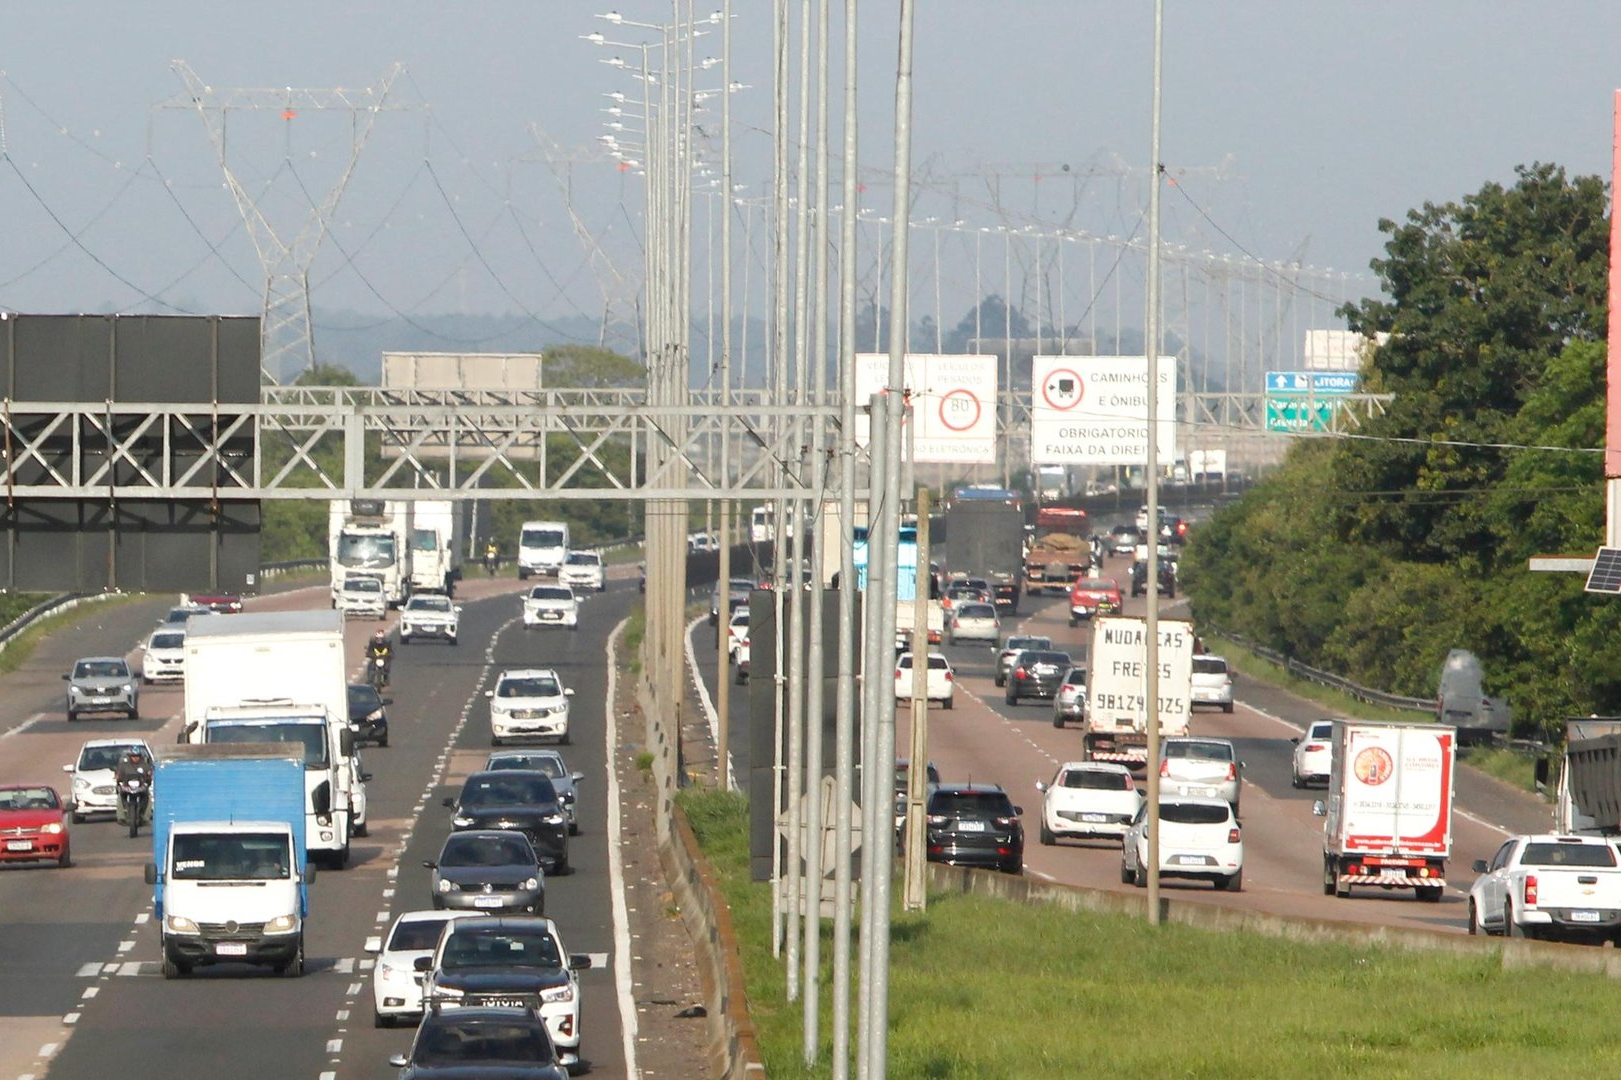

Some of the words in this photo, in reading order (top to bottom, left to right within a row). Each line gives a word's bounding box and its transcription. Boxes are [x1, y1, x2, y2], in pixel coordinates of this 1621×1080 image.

[1090, 370, 1168, 383] CAMINHÕS
[950, 398, 969, 412] 80
[1098, 396, 1107, 406] E
[1110, 394, 1159, 407] ÔNIBU
[1045, 444, 1083, 455] FAIXA
[1088, 445, 1106, 455] DA
[1111, 445, 1161, 455] DIREIA
[1104, 629, 1183, 648] MUDAAS
[1112, 661, 1171, 679] FRES
